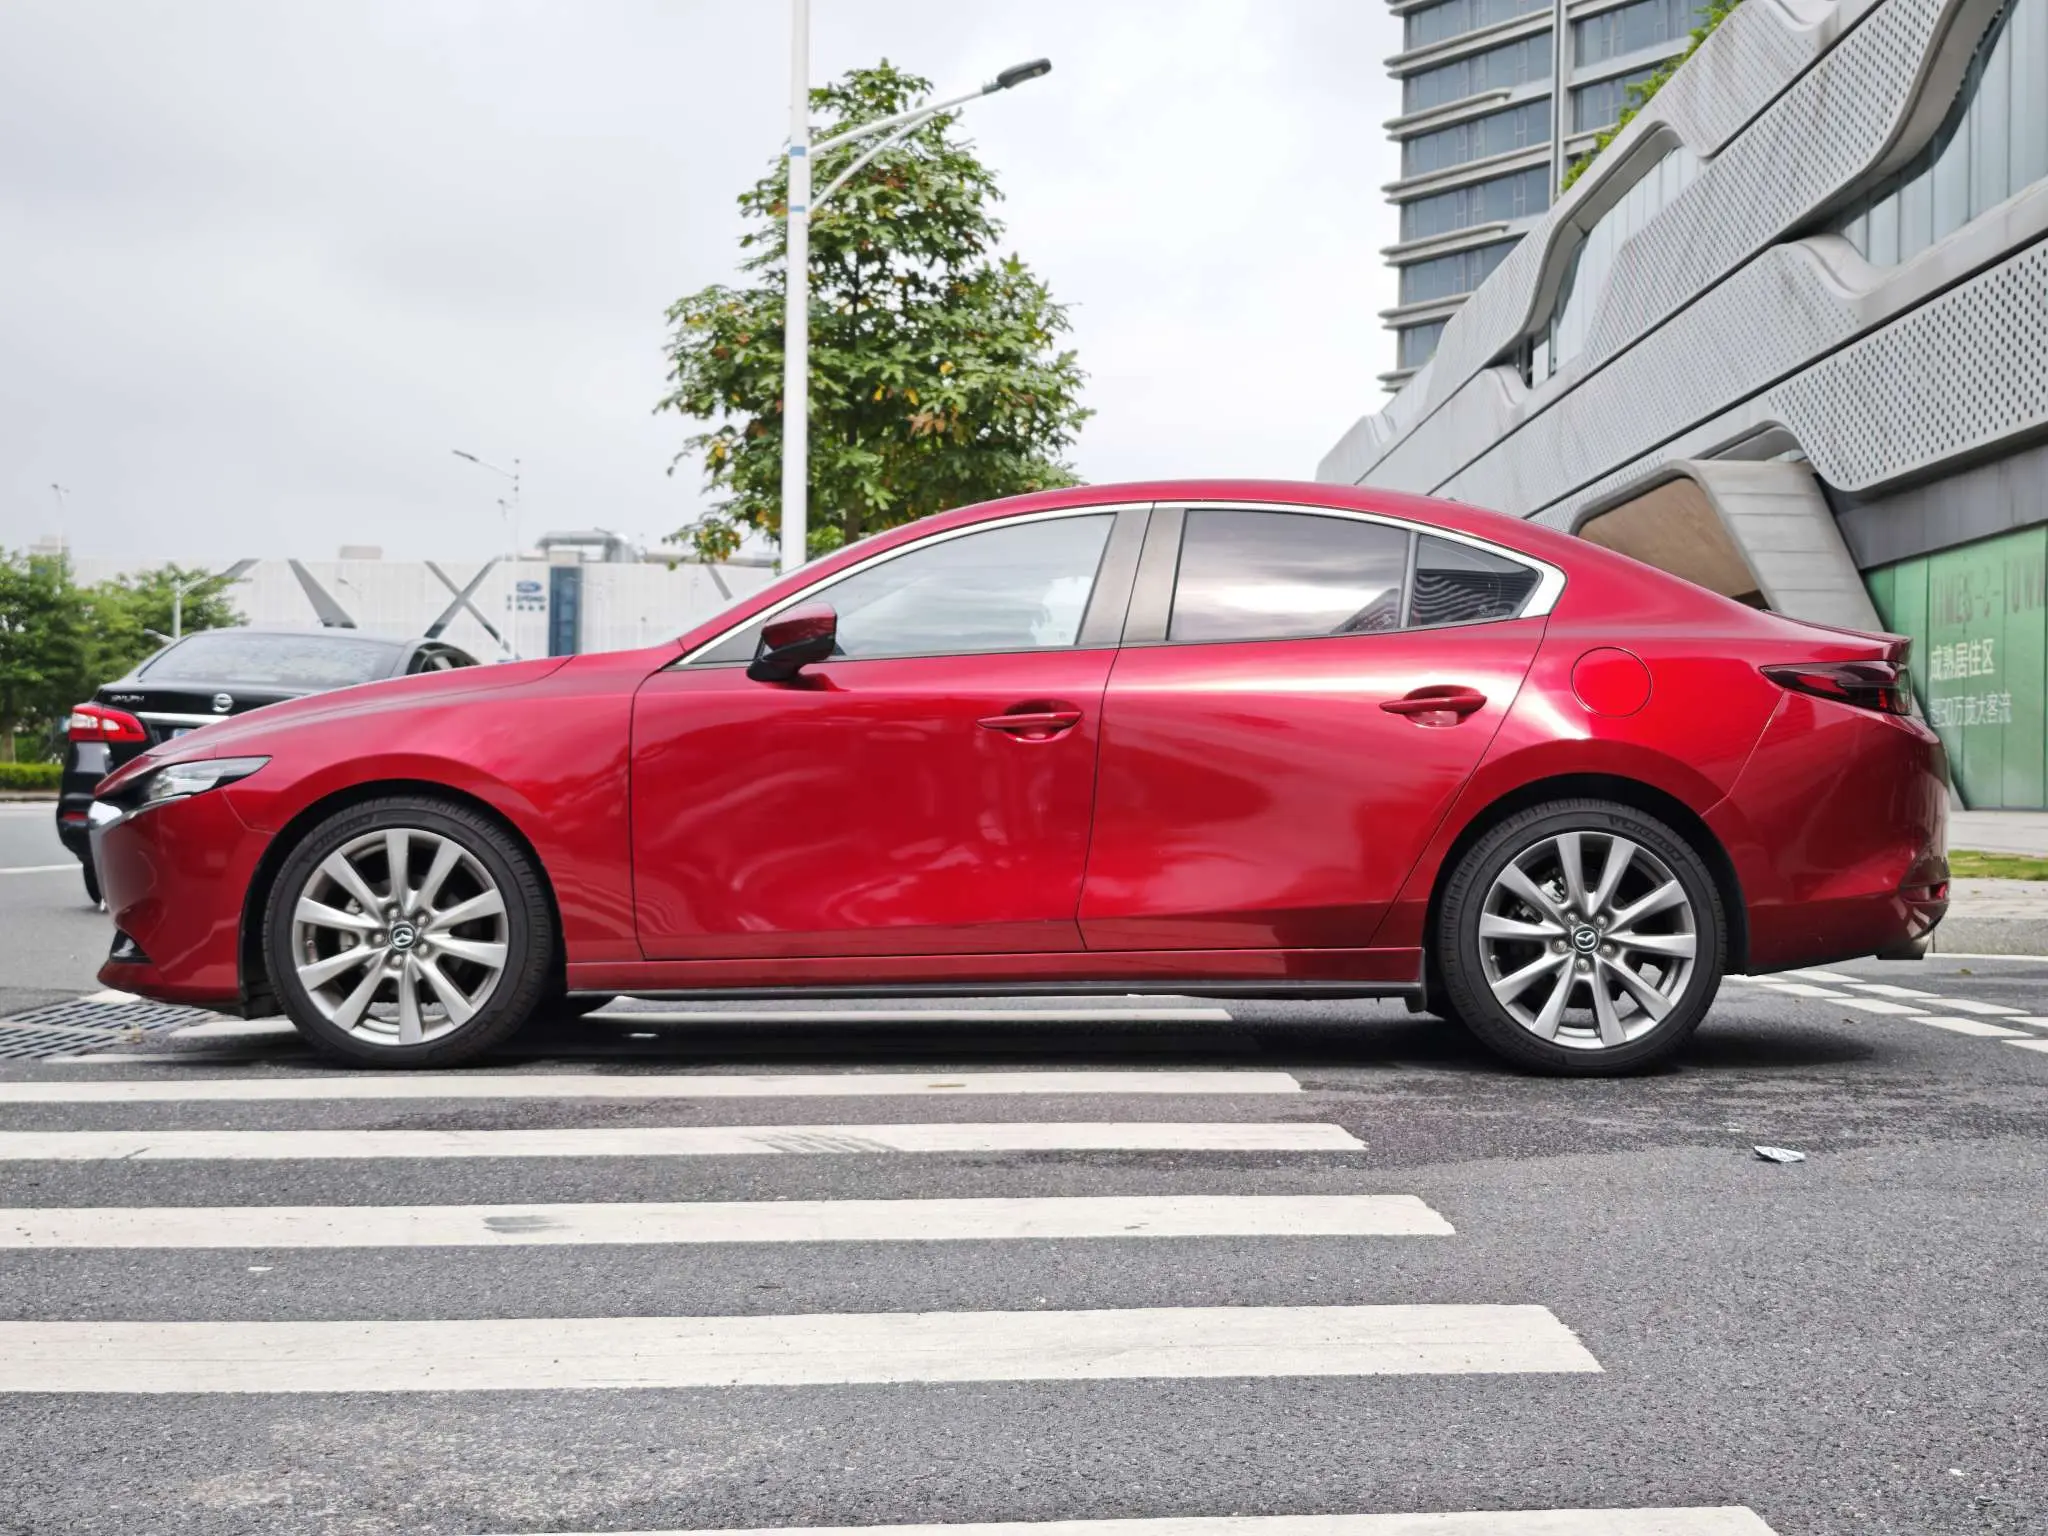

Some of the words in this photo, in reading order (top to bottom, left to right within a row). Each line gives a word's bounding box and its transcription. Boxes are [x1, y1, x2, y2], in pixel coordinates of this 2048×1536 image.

[1930, 638, 1995, 681] 成熟居住区
